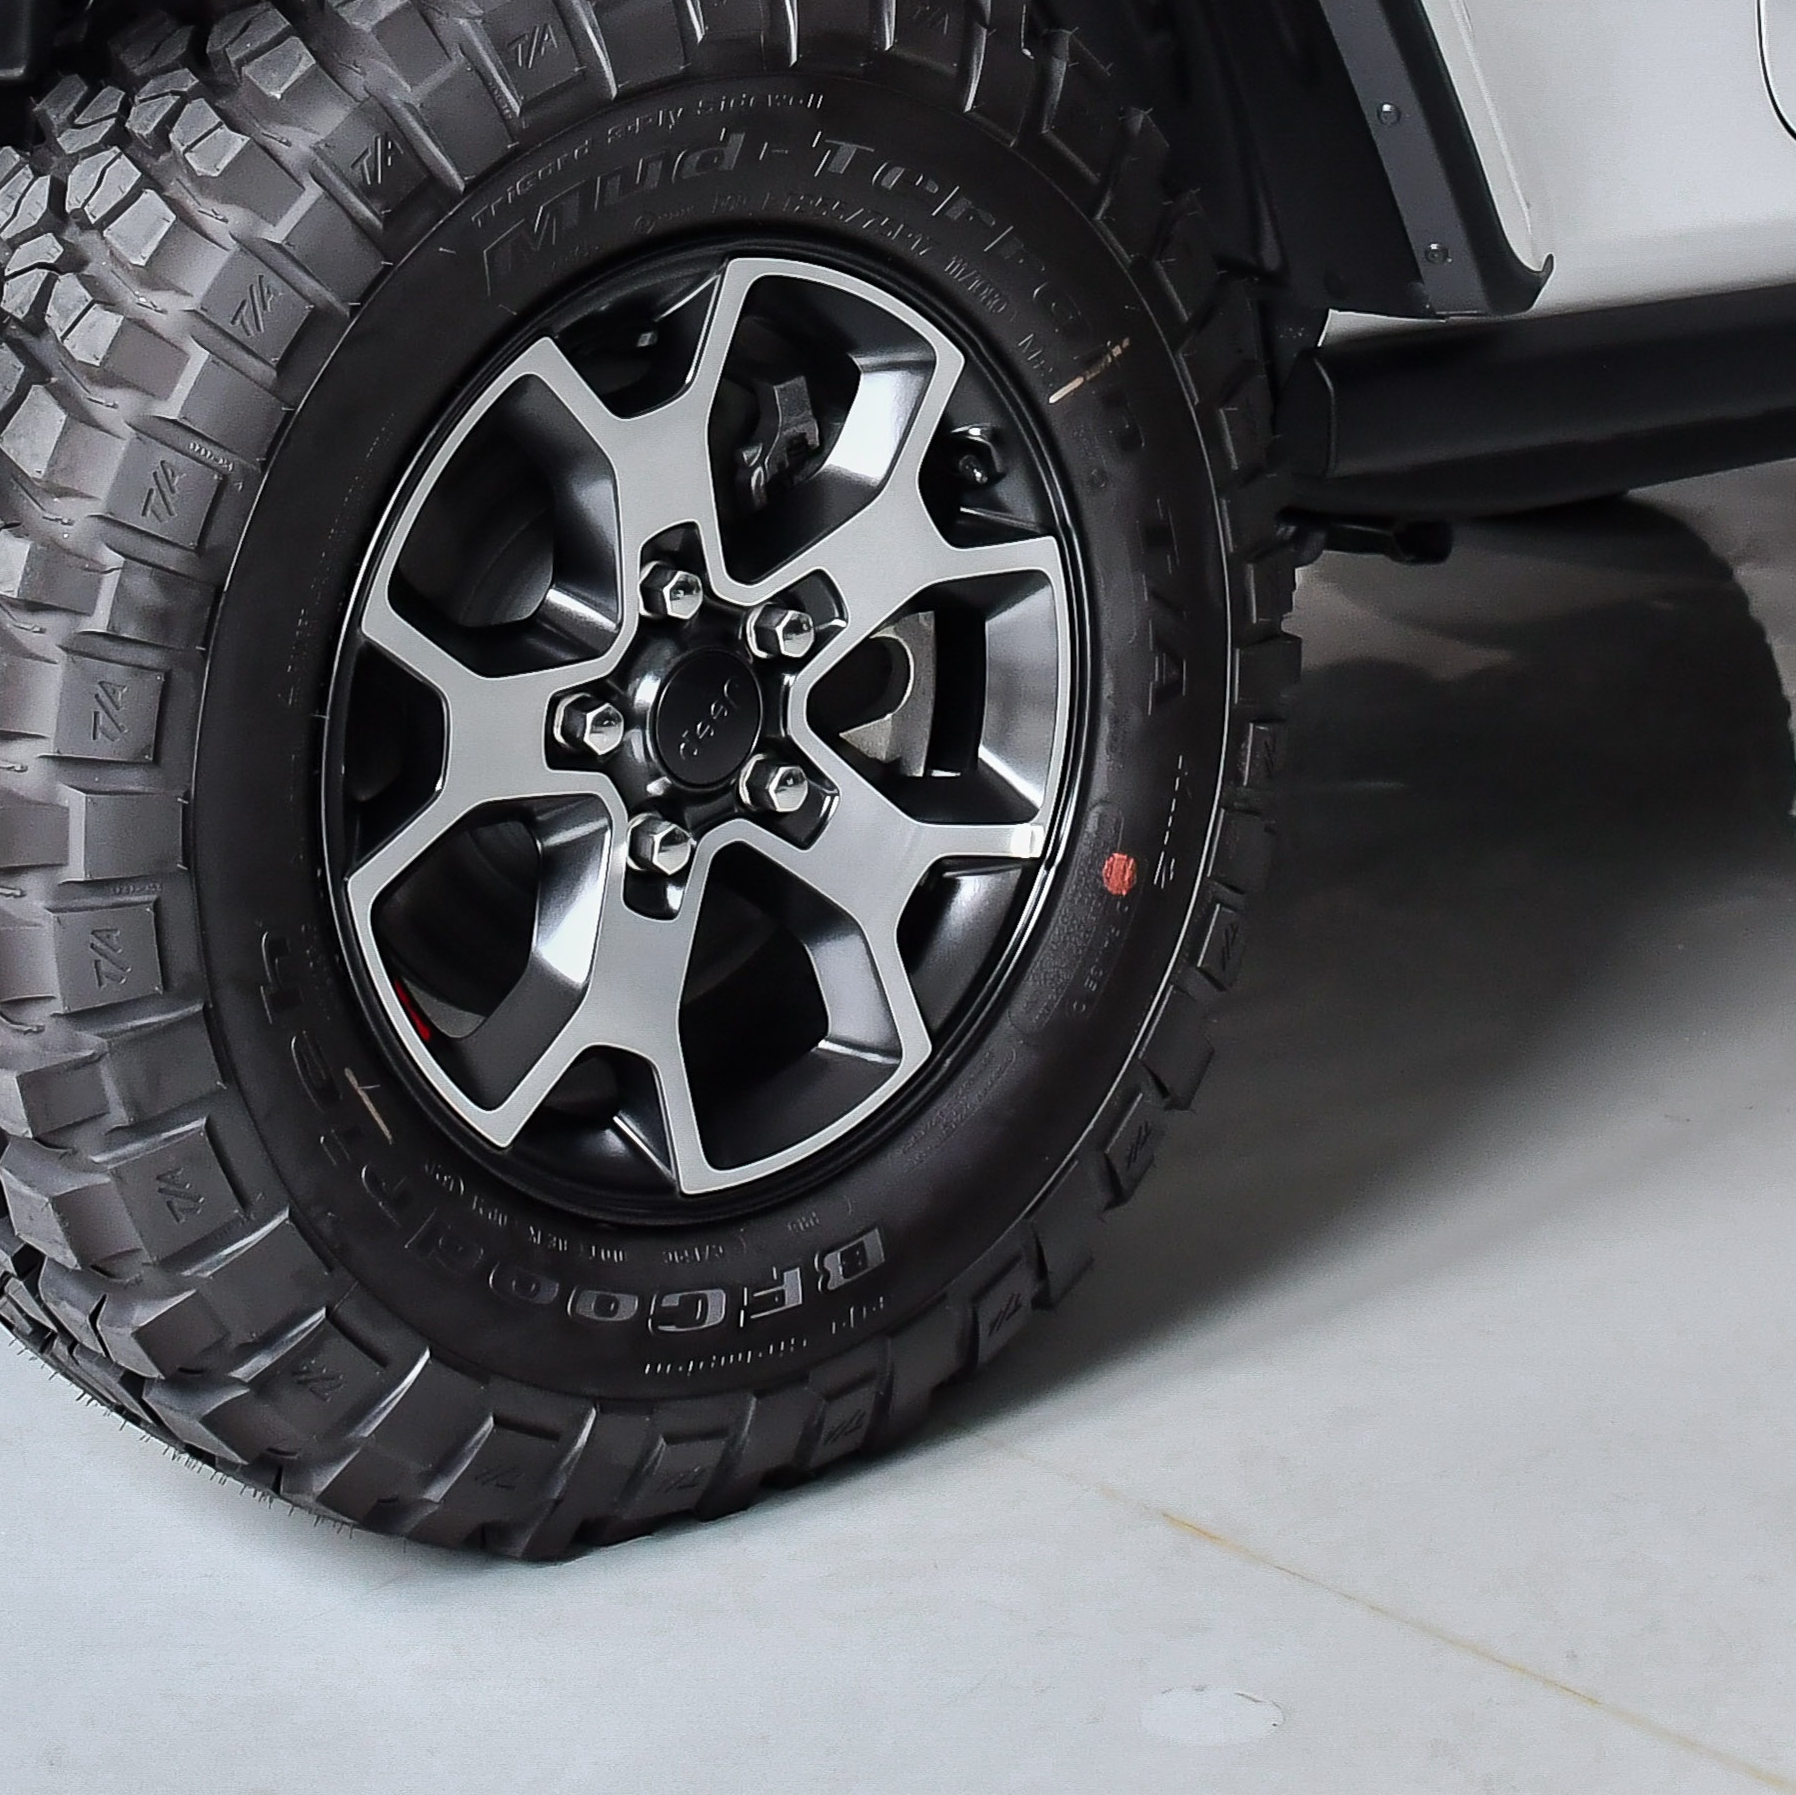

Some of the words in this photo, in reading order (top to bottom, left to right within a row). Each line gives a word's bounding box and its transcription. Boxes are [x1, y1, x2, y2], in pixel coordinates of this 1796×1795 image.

[508, 30, 559, 68] T/A
[352, 135, 403, 188] T/A
[231, 274, 279, 338] T/A
[141, 459, 185, 523] T/A
[92, 679, 128, 743] T/A
[96, 926, 133, 992] T/A
[159, 1168, 205, 1224] T/A
